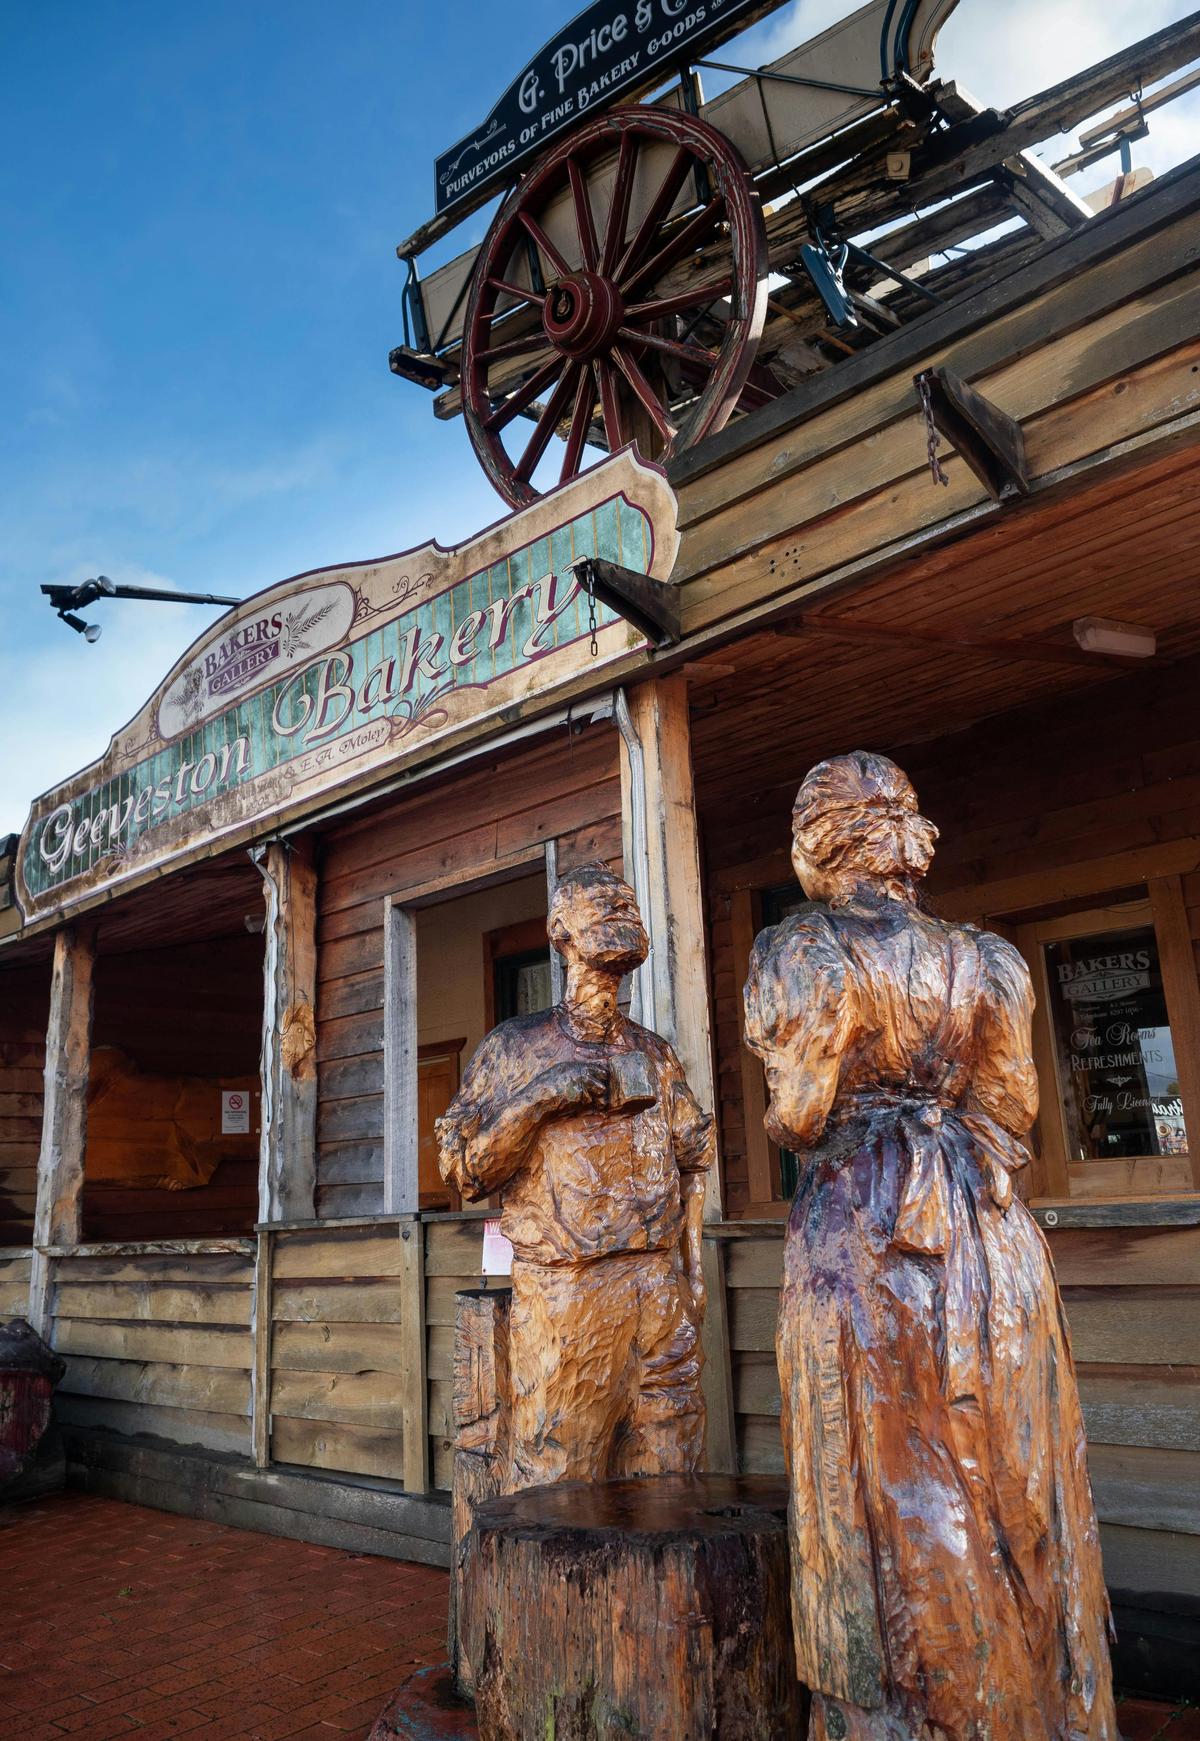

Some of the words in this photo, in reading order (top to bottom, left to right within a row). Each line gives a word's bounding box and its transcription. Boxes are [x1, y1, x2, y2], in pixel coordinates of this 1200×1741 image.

[518, 70, 546, 114] G.
[550, 14, 628, 94] Price
[445, 139, 516, 199] PURVEYORS
[519, 122, 539, 144] OF
[541, 99, 574, 130] FINE
[577, 51, 641, 110] BAKERY
[647, 6, 706, 55] GOODS
[204, 611, 284, 680] BAKERS
[211, 643, 278, 693] GALLERY
[39, 737, 251, 874] Geeveston
[272, 555, 588, 745] Bakery
[1057, 950, 1151, 983] BAKERS
[1067, 975, 1143, 996] GALLERY
[1071, 1027, 1102, 1050] Tea
[1106, 1022, 1156, 1046] Rooms
[1071, 1049, 1163, 1072] REFRESHMENTS
[1082, 1094, 1114, 1115] Fully
